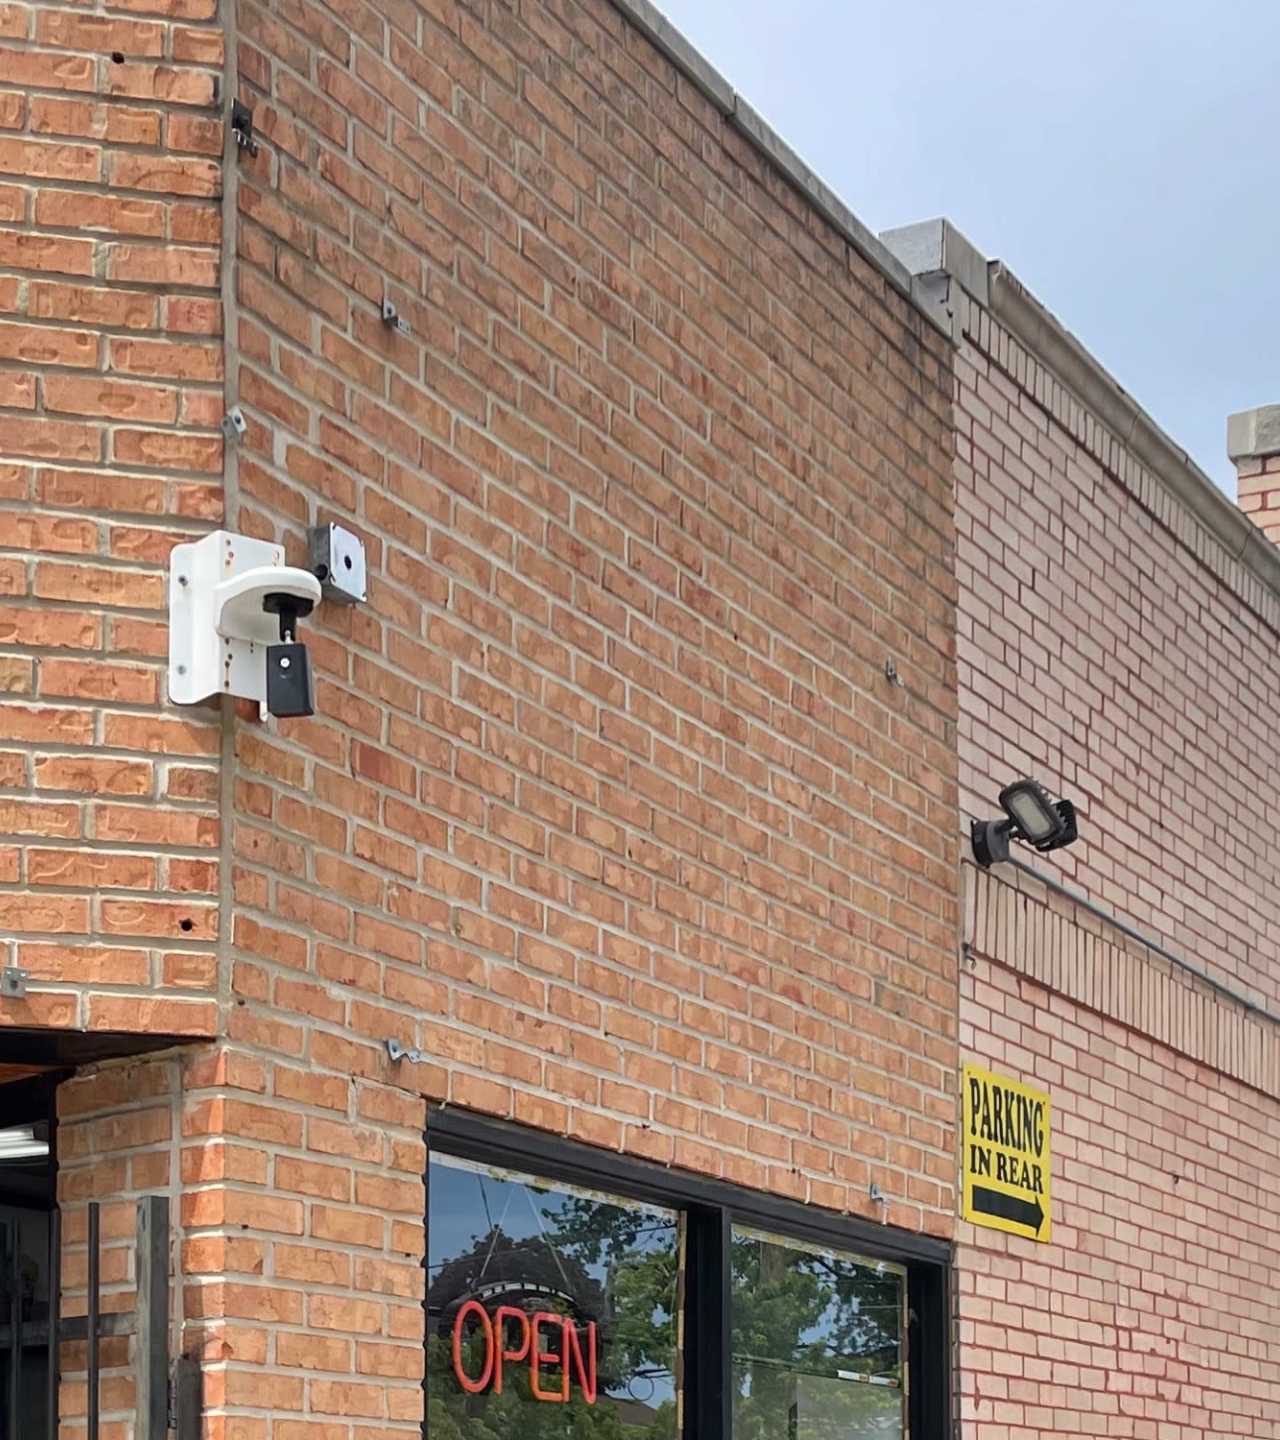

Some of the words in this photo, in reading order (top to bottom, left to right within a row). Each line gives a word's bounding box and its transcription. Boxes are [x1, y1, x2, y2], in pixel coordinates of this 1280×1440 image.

[970, 1078, 1044, 1158] PARKING
[970, 1144, 991, 1177] IN
[996, 1152, 1044, 1194] REAR
[452, 1300, 597, 1404] OPEN
